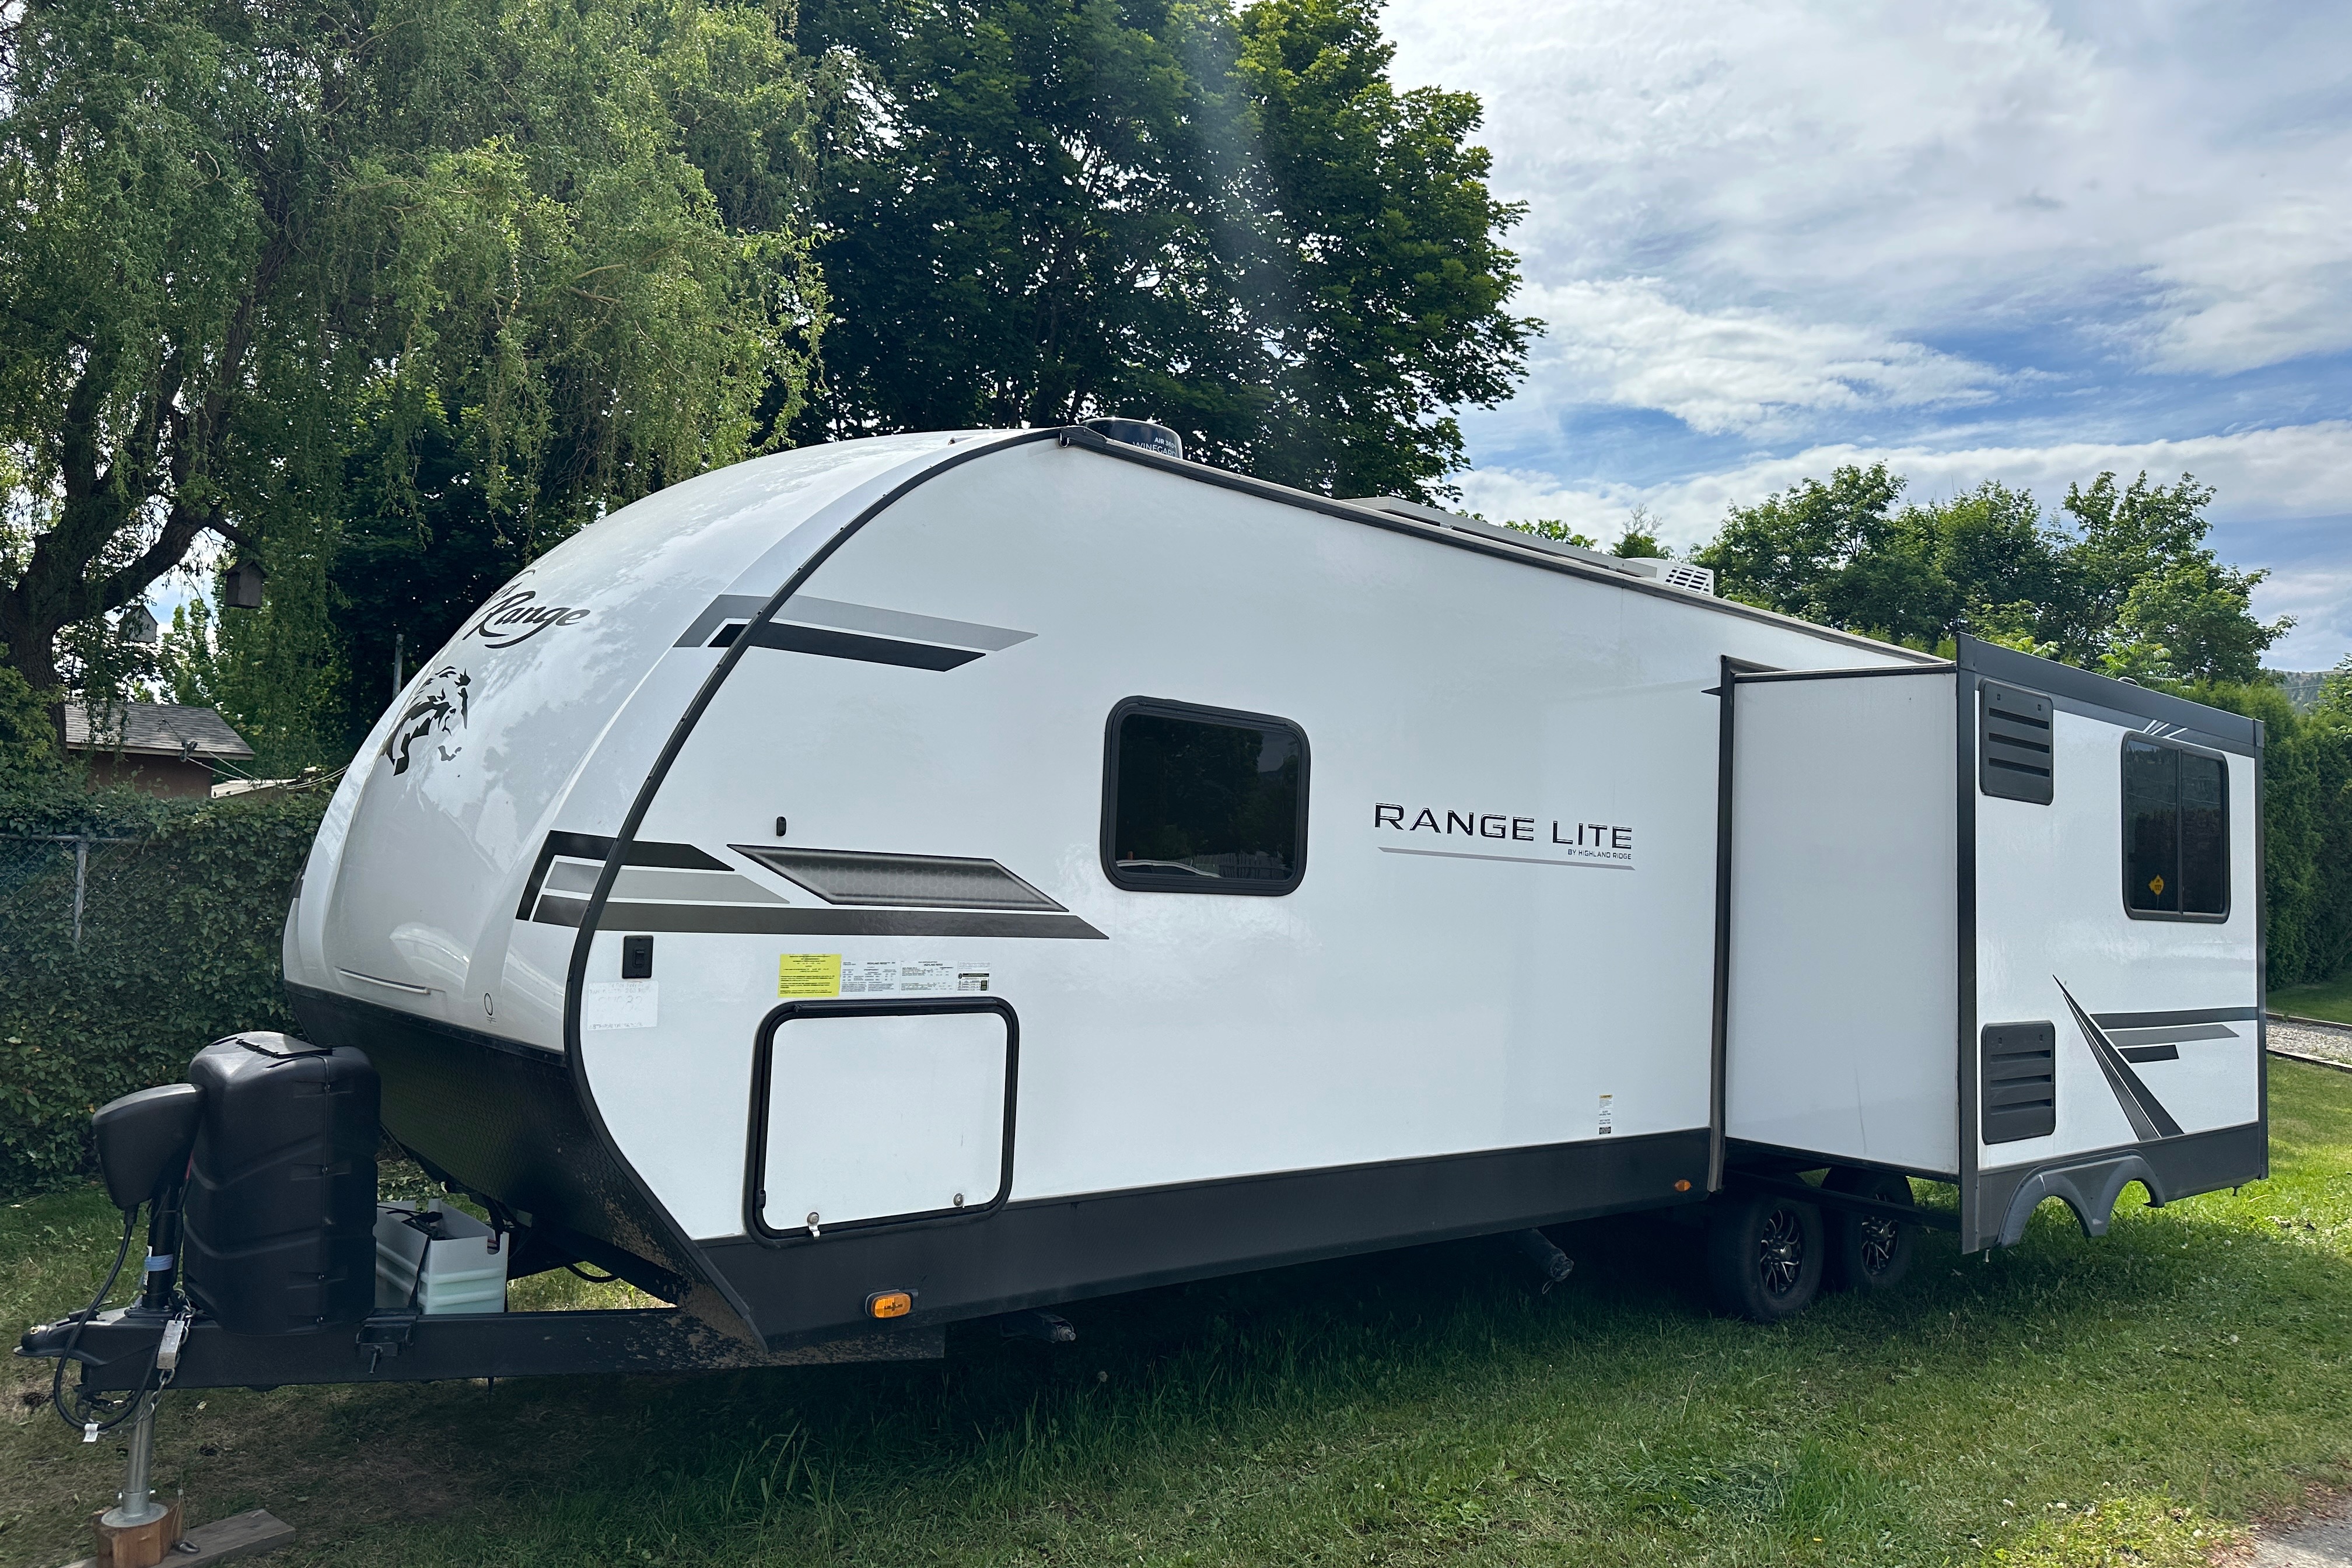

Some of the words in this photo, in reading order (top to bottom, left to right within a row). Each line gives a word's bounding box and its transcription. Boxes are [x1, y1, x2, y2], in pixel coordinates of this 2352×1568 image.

[1132, 441, 1177, 457] WINEGARD
[1154, 437, 1164, 445] AIR
[463, 590, 591, 649] Range
[1374, 802, 1535, 842] RANGE
[1552, 820, 1632, 849] LITE
[1578, 850, 1611, 858] HIGHLAND
